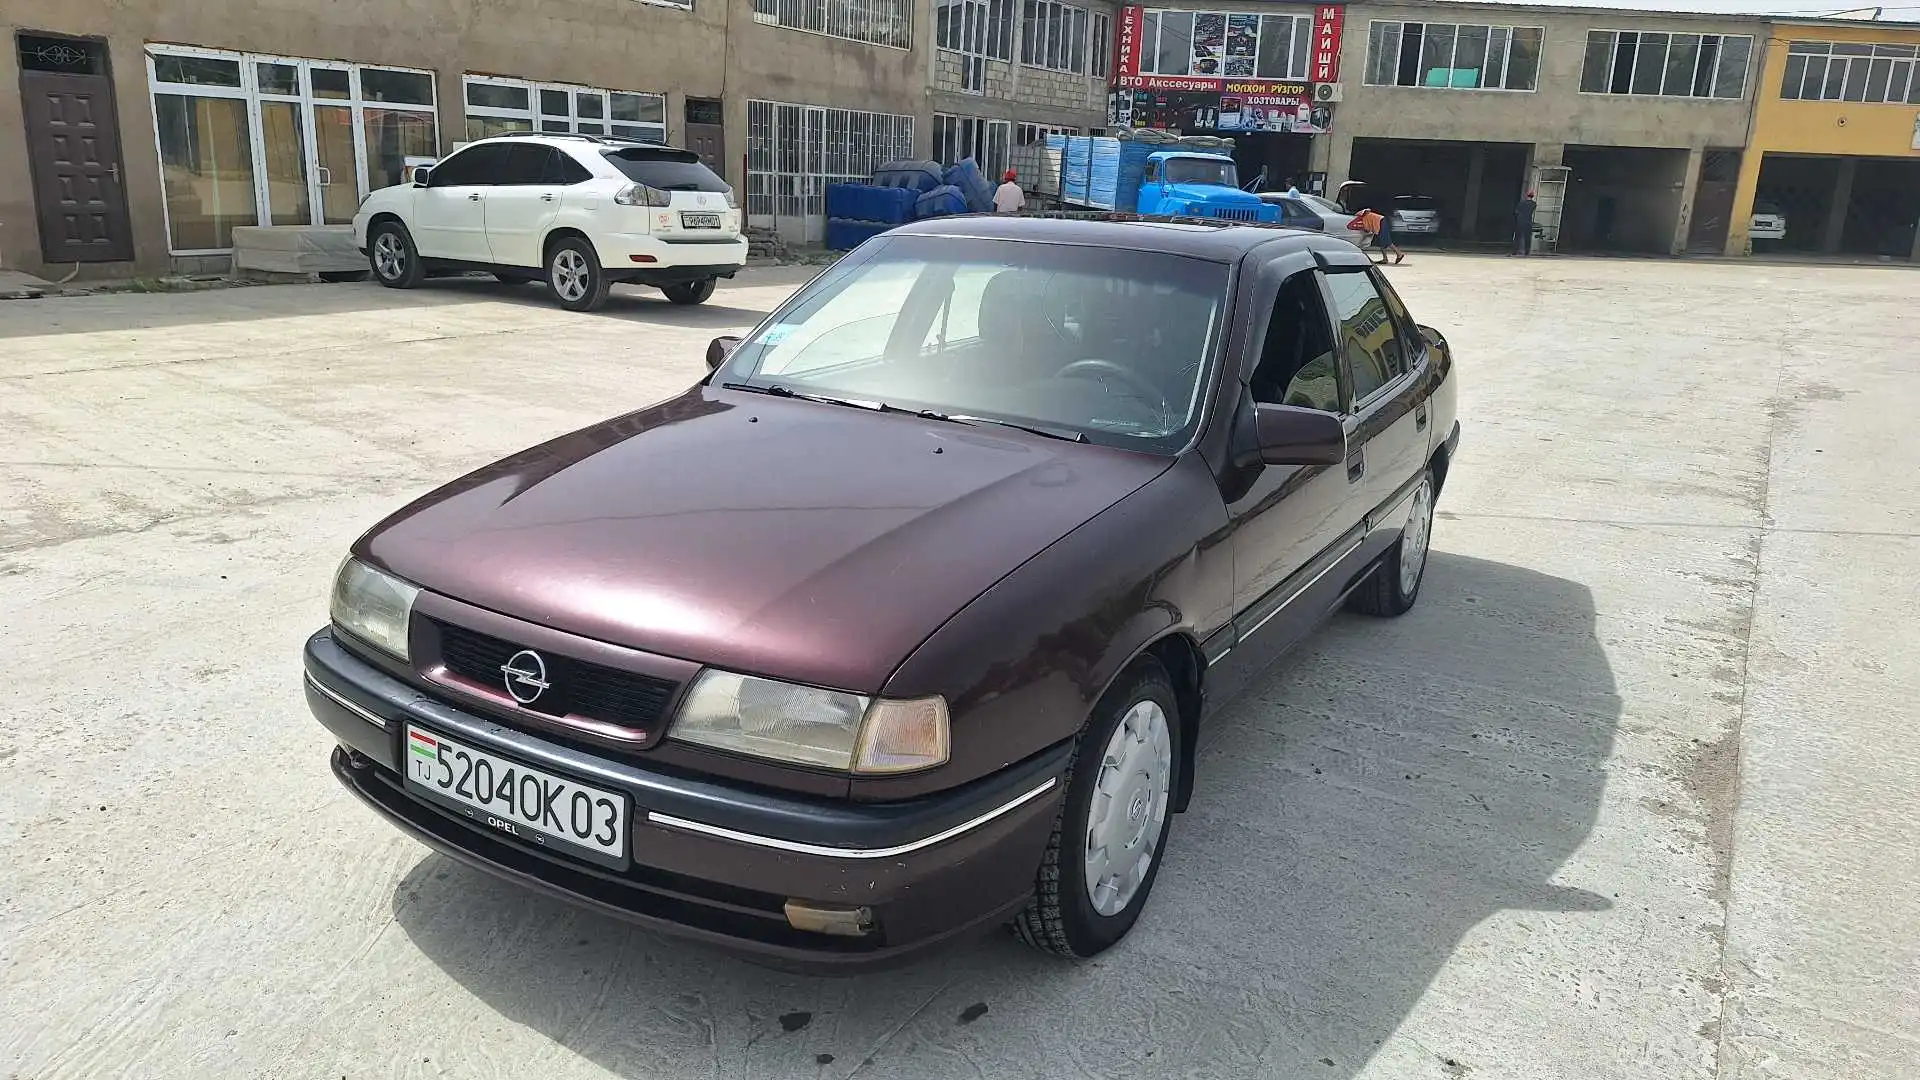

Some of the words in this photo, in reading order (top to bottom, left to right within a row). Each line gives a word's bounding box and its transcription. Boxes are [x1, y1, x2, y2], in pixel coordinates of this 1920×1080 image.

[1119, 6, 1135, 73] ТЕХНИКА
[1148, 77, 1217, 91] Акссесуары
[1247, 96, 1299, 106] ХОЗТОВАРЫ
[416, 759, 431, 781] TJ
[487, 816, 519, 835] OPEL
